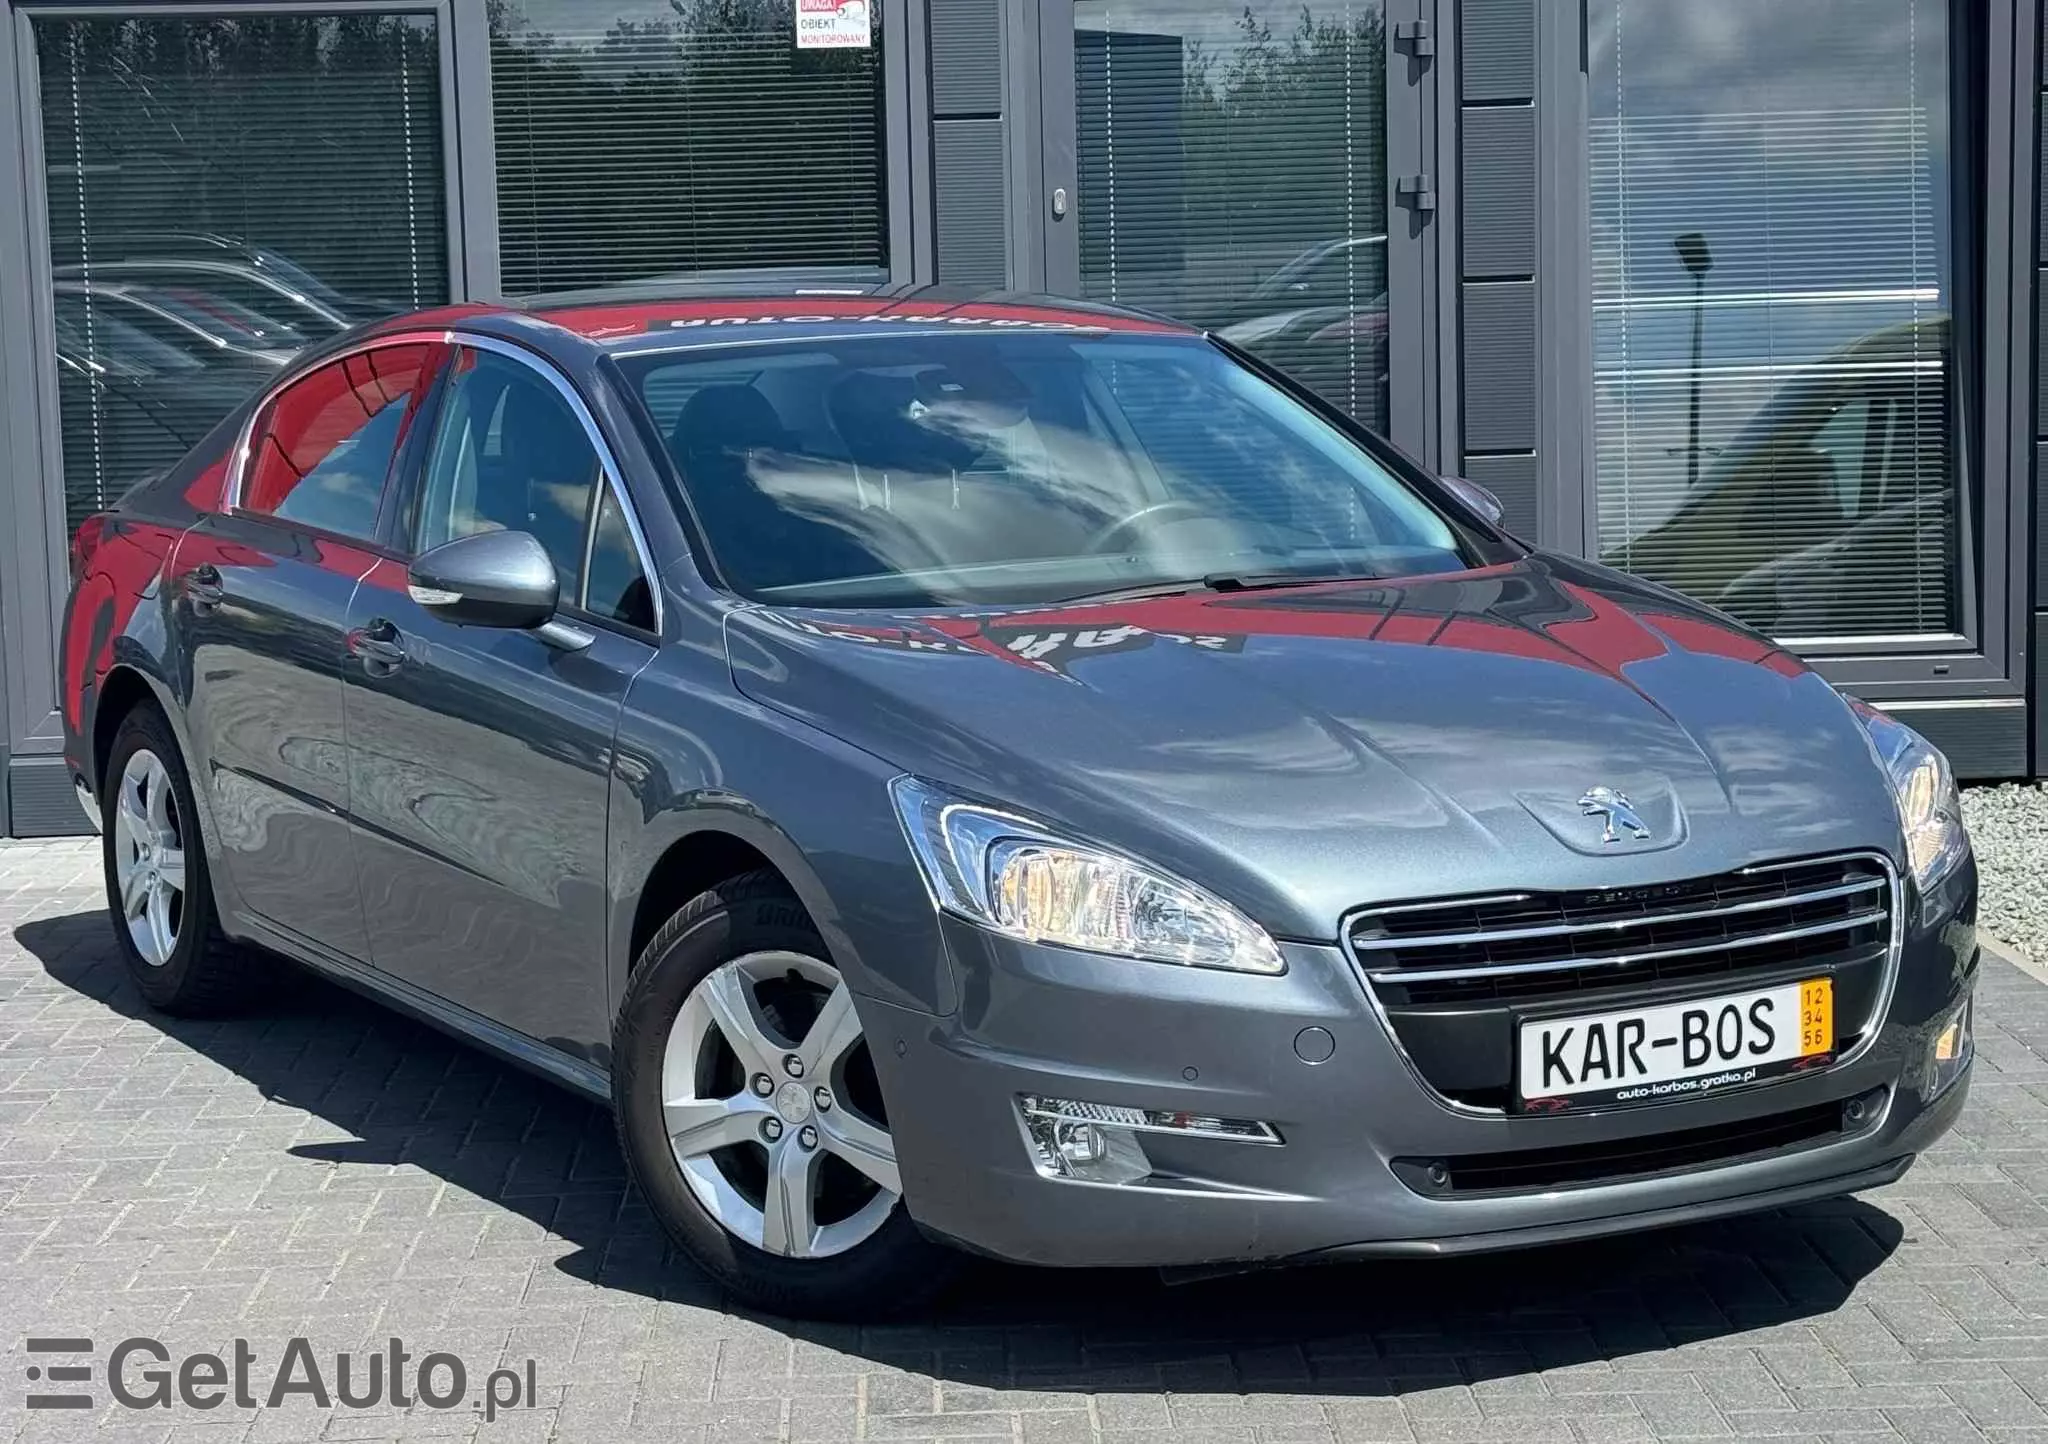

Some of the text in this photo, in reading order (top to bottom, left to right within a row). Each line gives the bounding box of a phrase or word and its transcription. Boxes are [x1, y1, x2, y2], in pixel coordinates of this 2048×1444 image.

[800, 18, 836, 29] OBIEKT
[800, 34, 866, 44] MONITOROWANY
[1805, 987, 1823, 1005] 12
[1803, 1008, 1823, 1026] 34
[1542, 997, 1776, 1088] KAR-BOS
[1804, 1029, 1823, 1047] 56
[1616, 1067, 1756, 1100] auto-karbos.gratka.pl
